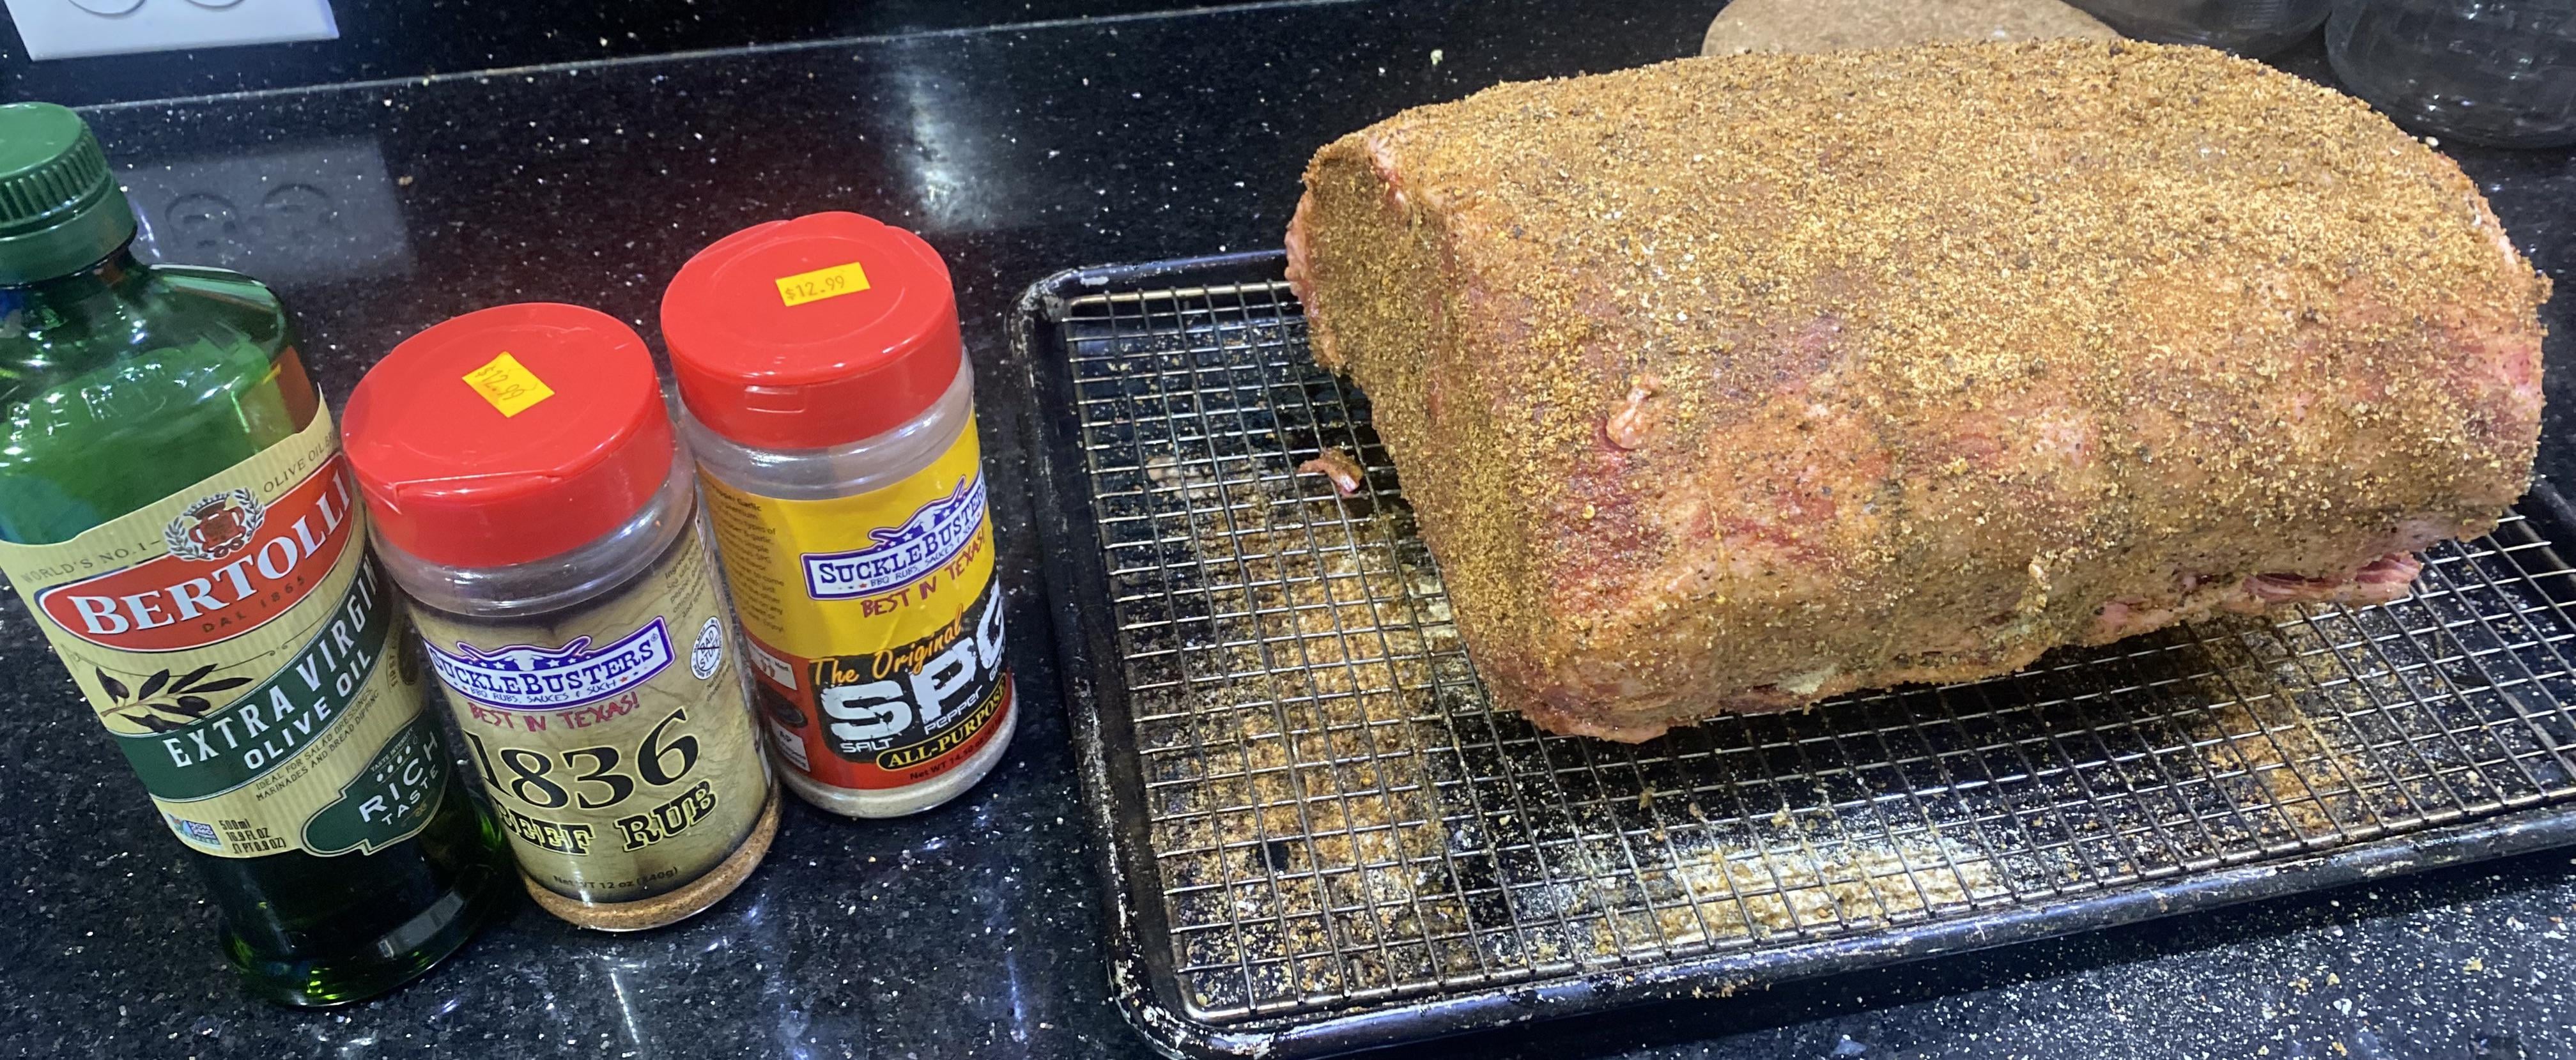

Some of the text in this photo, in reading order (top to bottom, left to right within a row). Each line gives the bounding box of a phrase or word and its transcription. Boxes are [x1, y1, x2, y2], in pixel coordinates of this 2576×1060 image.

[785, 275, 844, 300] $12.99
[475, 364, 525, 401] $12.99
[263, 442, 325, 493] OLIVE OIL
[20, 558, 93, 583] WORLD'S
[67, 469, 350, 634] BERTOLLI
[870, 576, 890, 587] BBQ
[925, 544, 954, 567] SAUCES
[201, 575, 305, 634] DAL 1865
[861, 588, 910, 618] BEST
[920, 576, 937, 600] IN
[163, 554, 378, 767] EXTRA VIRGIN
[809, 658, 858, 685] The
[871, 603, 964, 680] Original
[243, 649, 371, 770] OLIVE OIL
[467, 691, 640, 732] BEST IN TEXAS!
[470, 687, 488, 698] BBQ
[527, 690, 569, 703] SAUCES
[587, 679, 617, 696] SUCH
[256, 689, 380, 801] MARINADES AND BREAD DIPPING
[256, 772, 285, 791] IDEAL
[285, 758, 304, 774] FOR
[304, 733, 333, 760] SALAD
[463, 705, 700, 810] 1836
[840, 737, 893, 753] SALT
[359, 732, 438, 823] RICH
[910, 770, 929, 780] Net
[930, 762, 946, 773] WT
[381, 764, 438, 826] TASTE
[219, 818, 251, 830] 500ml
[226, 831, 245, 842] 16.9
[245, 830, 257, 841] FL
[256, 827, 271, 839] OZ
[490, 778, 718, 856] BEEF RUB
[243, 842, 255, 853] PT
[270, 836, 287, 850] OZ)
[599, 880, 615, 889] 12
[617, 879, 635, 888] oz
